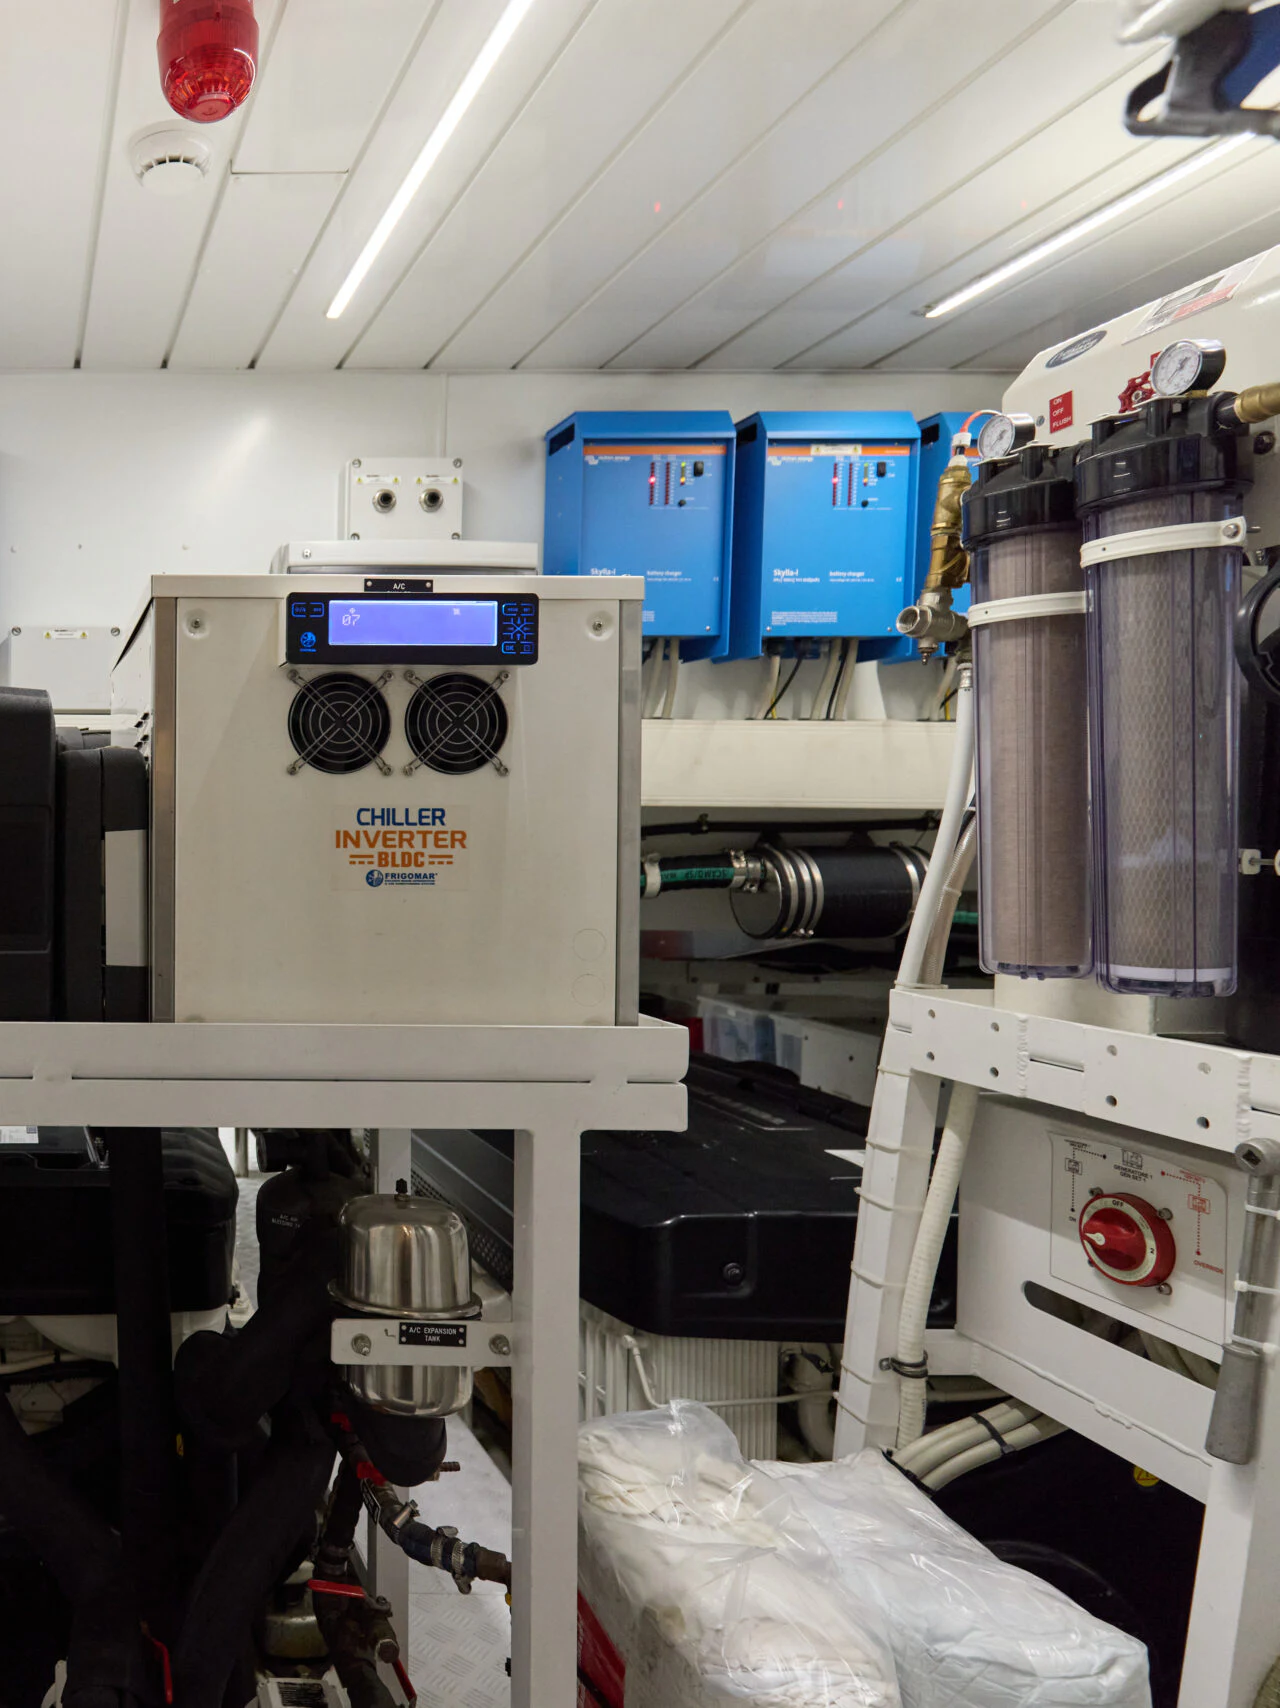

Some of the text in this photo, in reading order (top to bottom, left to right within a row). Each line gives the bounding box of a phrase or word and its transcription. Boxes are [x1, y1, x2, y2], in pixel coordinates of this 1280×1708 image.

[1052, 407, 1064, 417] OFF
[1052, 415, 1072, 428] FLUSH
[342, 614, 360, 626] 07
[356, 807, 446, 826] CHILLER
[335, 829, 467, 849] INVERTER
[377, 851, 425, 868] BLDC
[1113, 1164, 1149, 1179] GENERATORE
[1112, 1199, 1124, 1207] OFF
[409, 1326, 457, 1335] A/C EXPANSION
